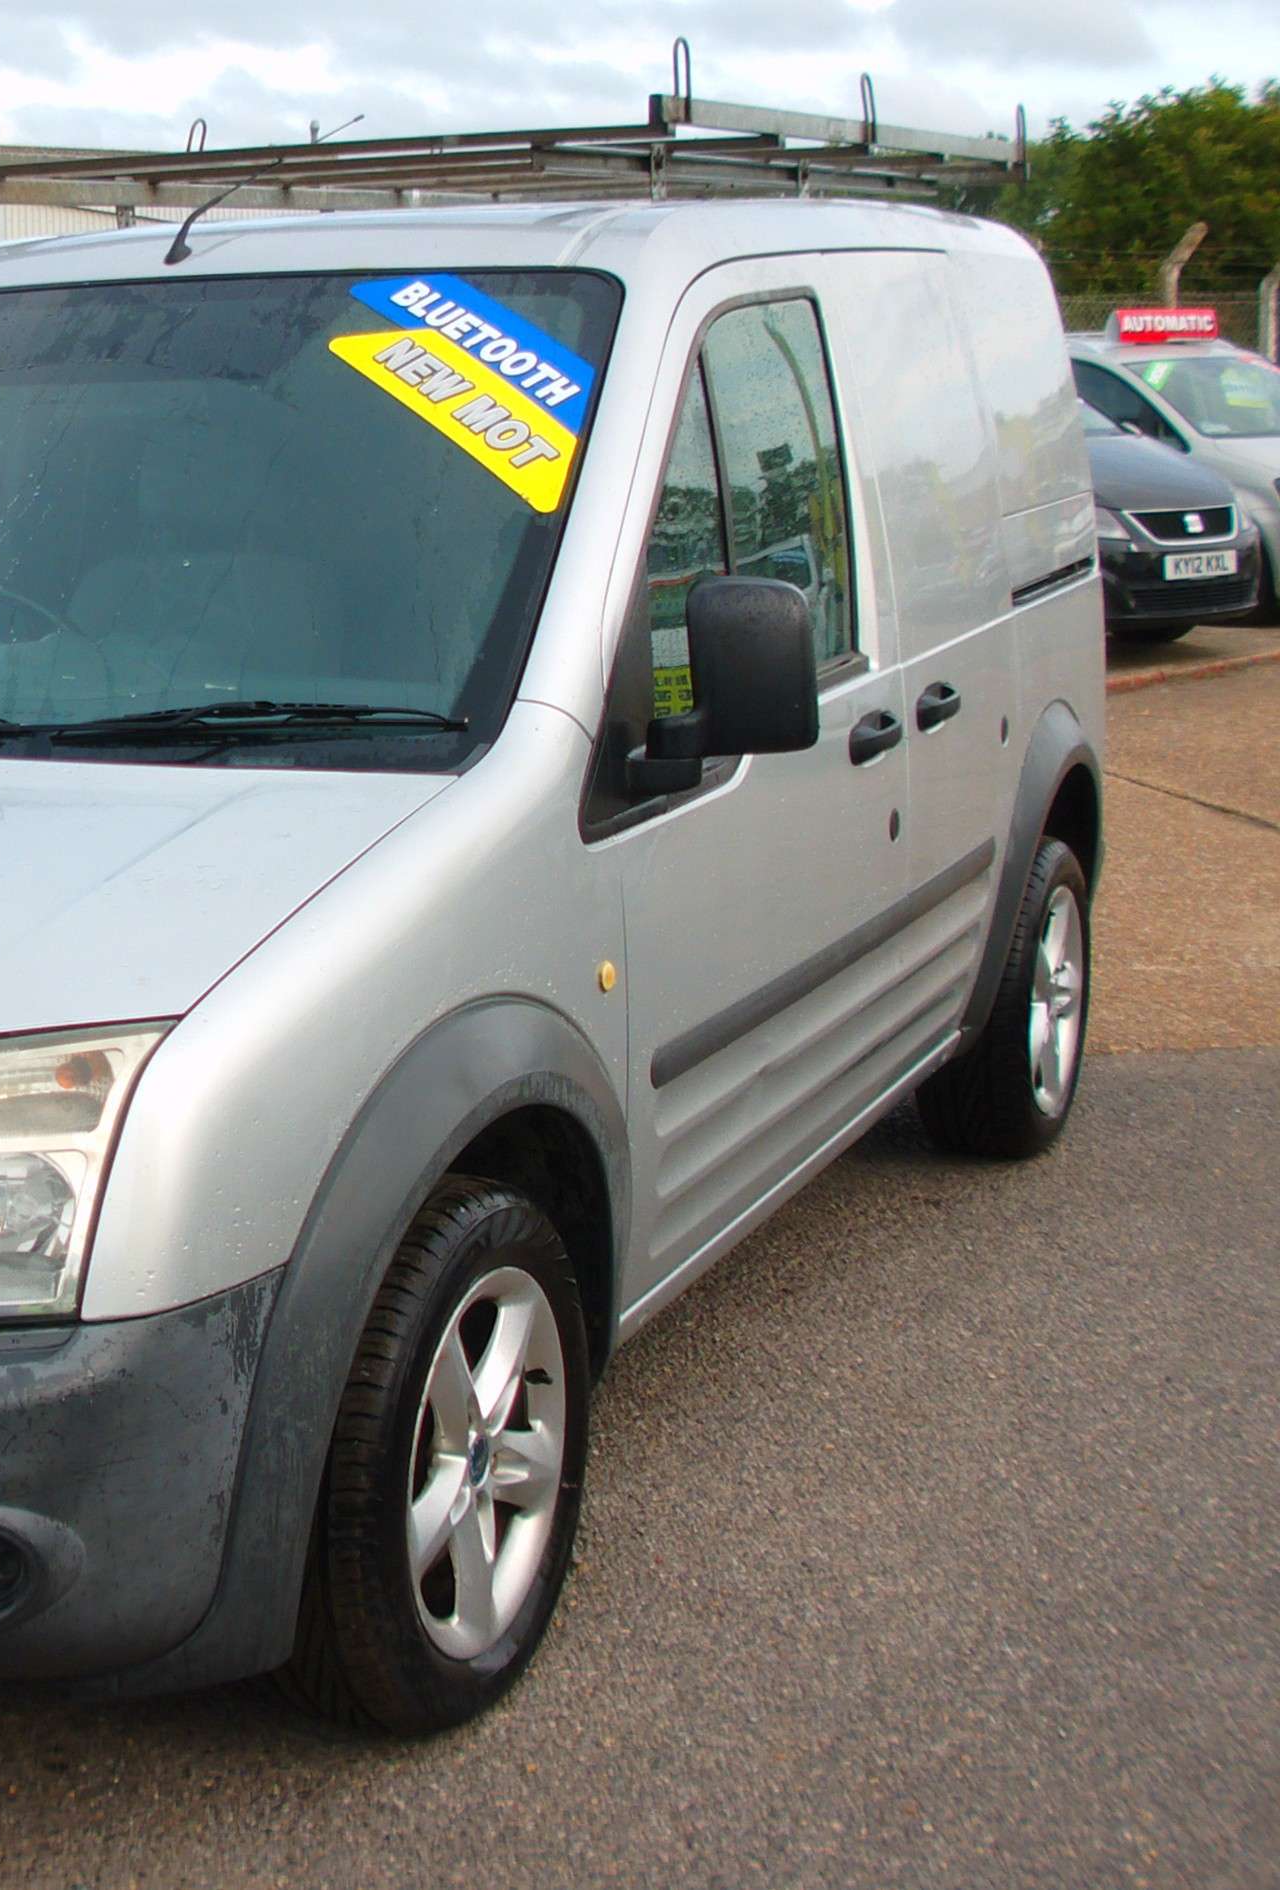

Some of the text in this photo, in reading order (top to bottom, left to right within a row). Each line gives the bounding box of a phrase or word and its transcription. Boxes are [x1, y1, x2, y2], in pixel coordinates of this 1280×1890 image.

[389, 280, 581, 407] BLUETOOTH
[1121, 315, 1214, 333] AUTOMATIC
[373, 336, 561, 469] NEW MOT
[1173, 554, 1229, 576] KY12 KXL
